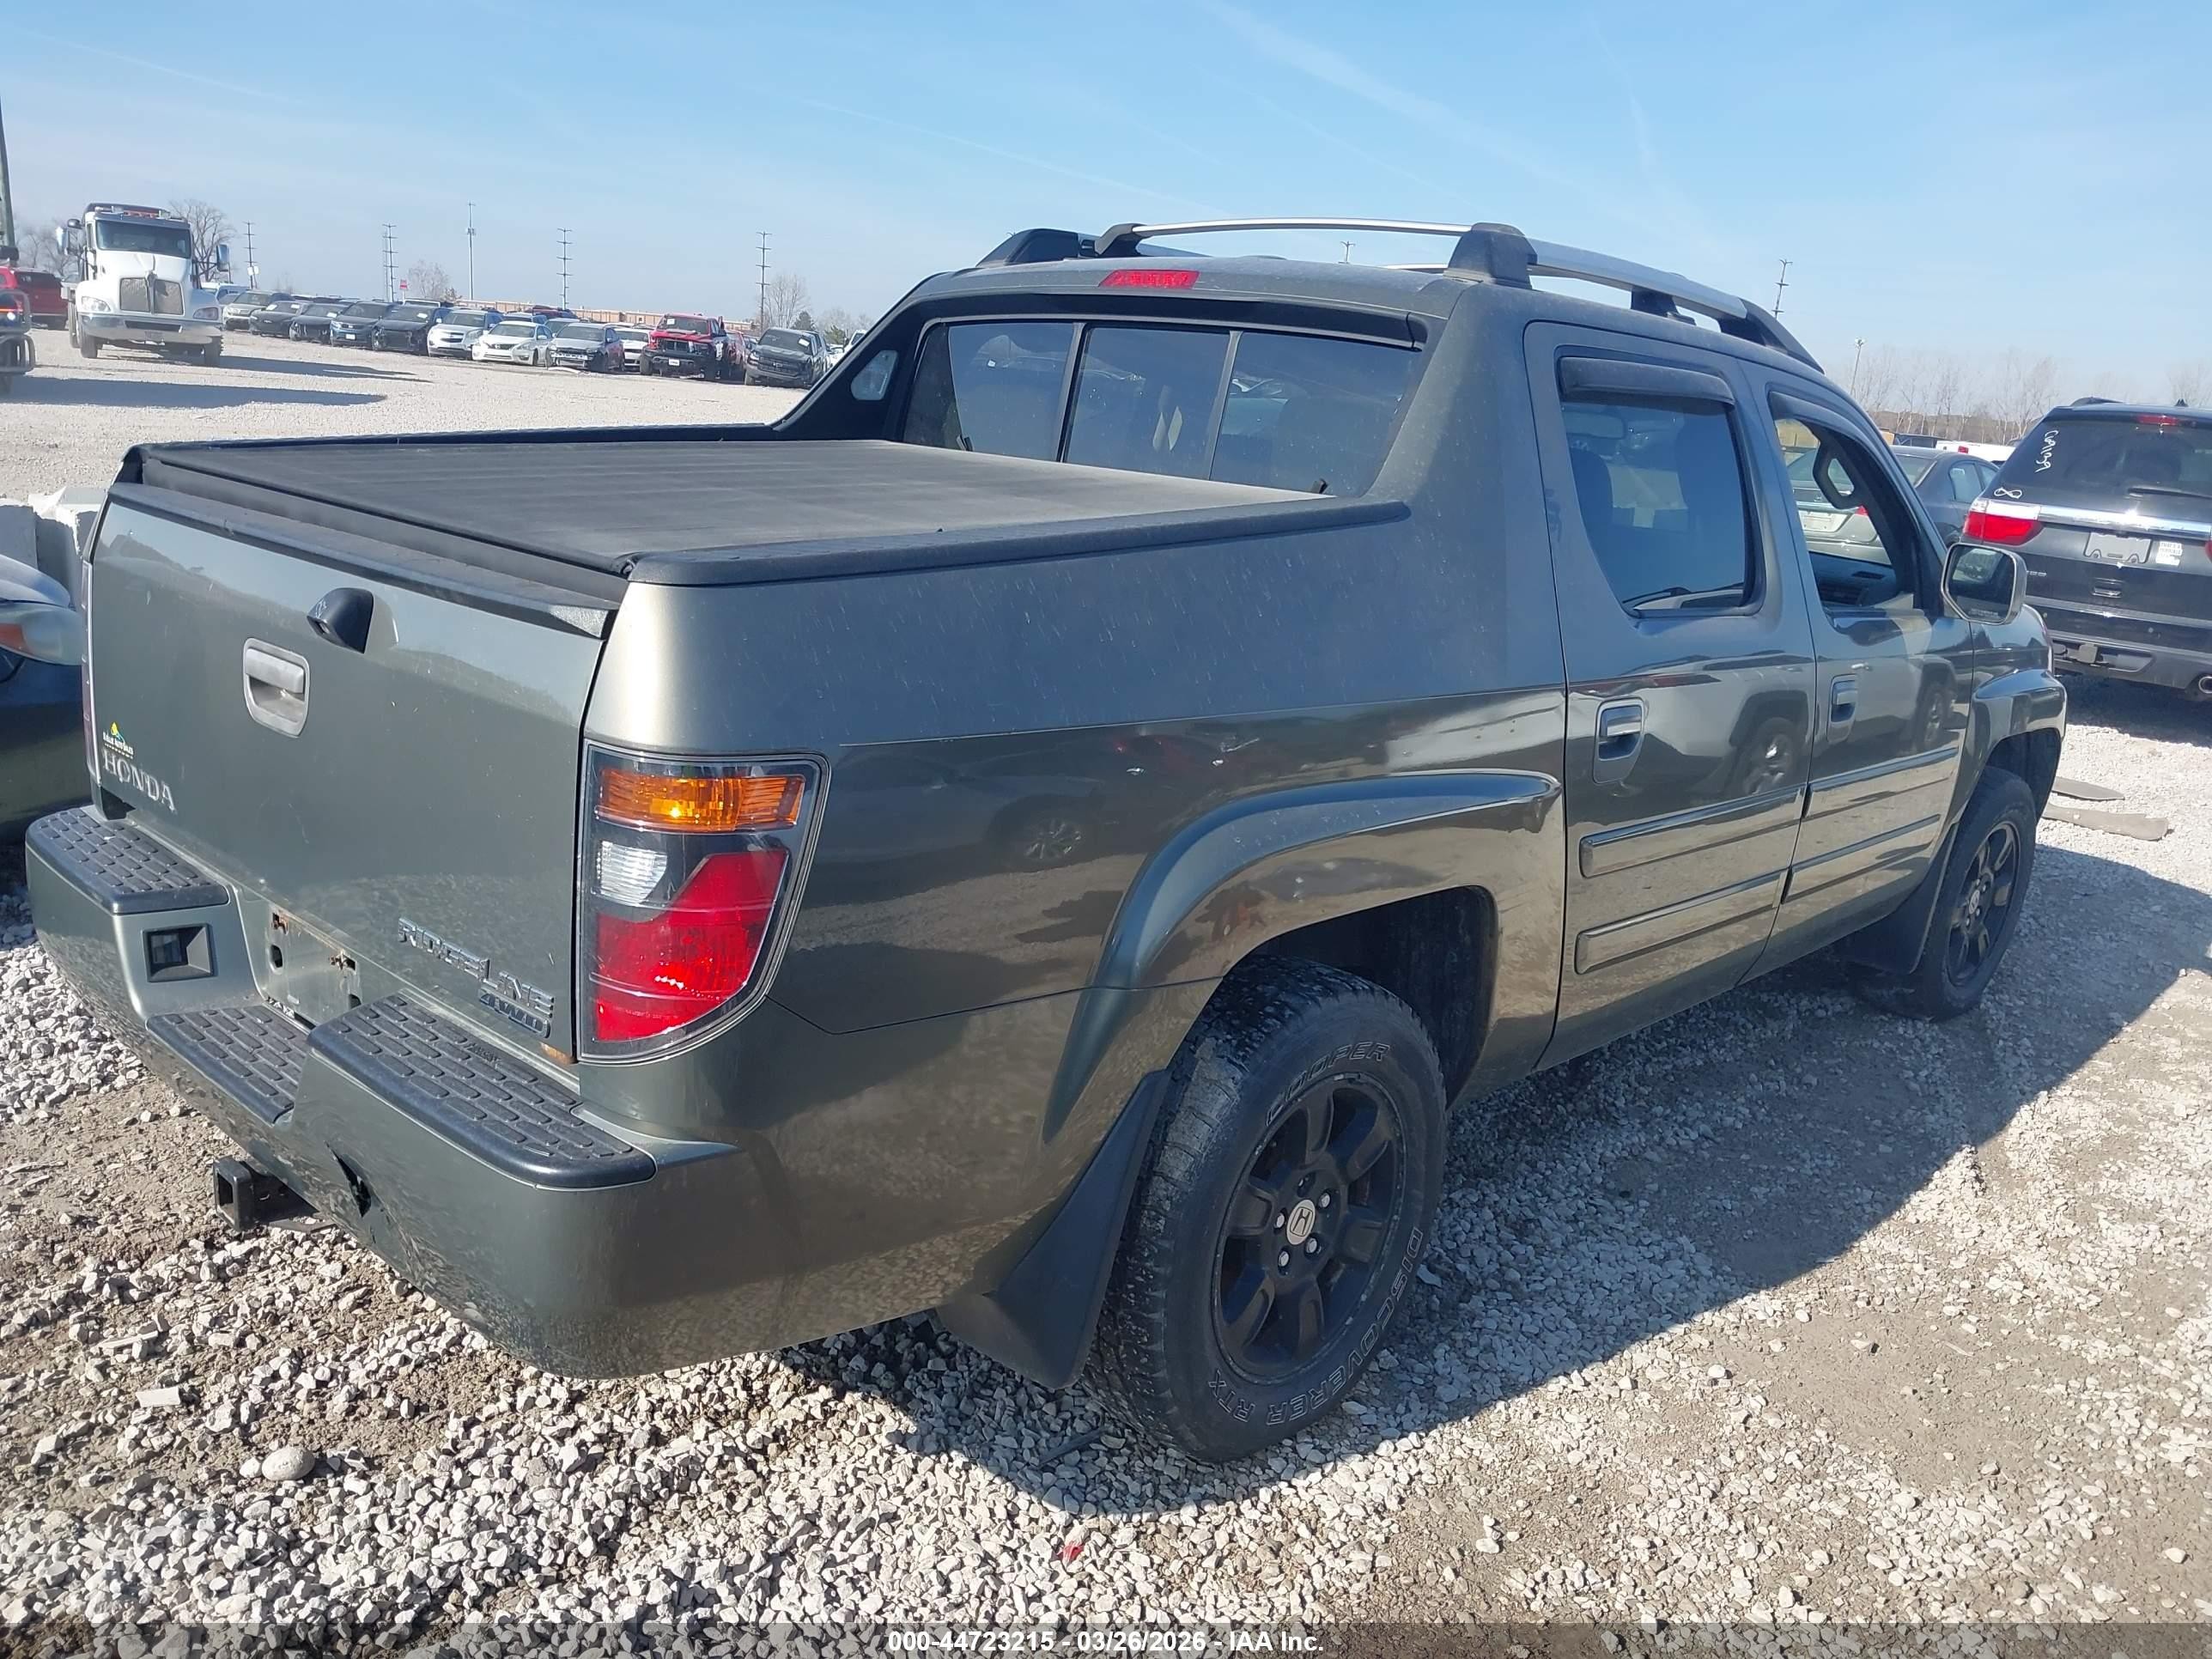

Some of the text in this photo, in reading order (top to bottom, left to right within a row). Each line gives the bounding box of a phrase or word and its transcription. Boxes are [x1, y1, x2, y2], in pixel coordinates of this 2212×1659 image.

[103, 748, 177, 814] HONDA
[398, 916, 556, 1019] RIDGELINE
[1266, 1041, 1391, 1127] COOPER
[1208, 1225, 1425, 1426] DISCOVERER RTX
